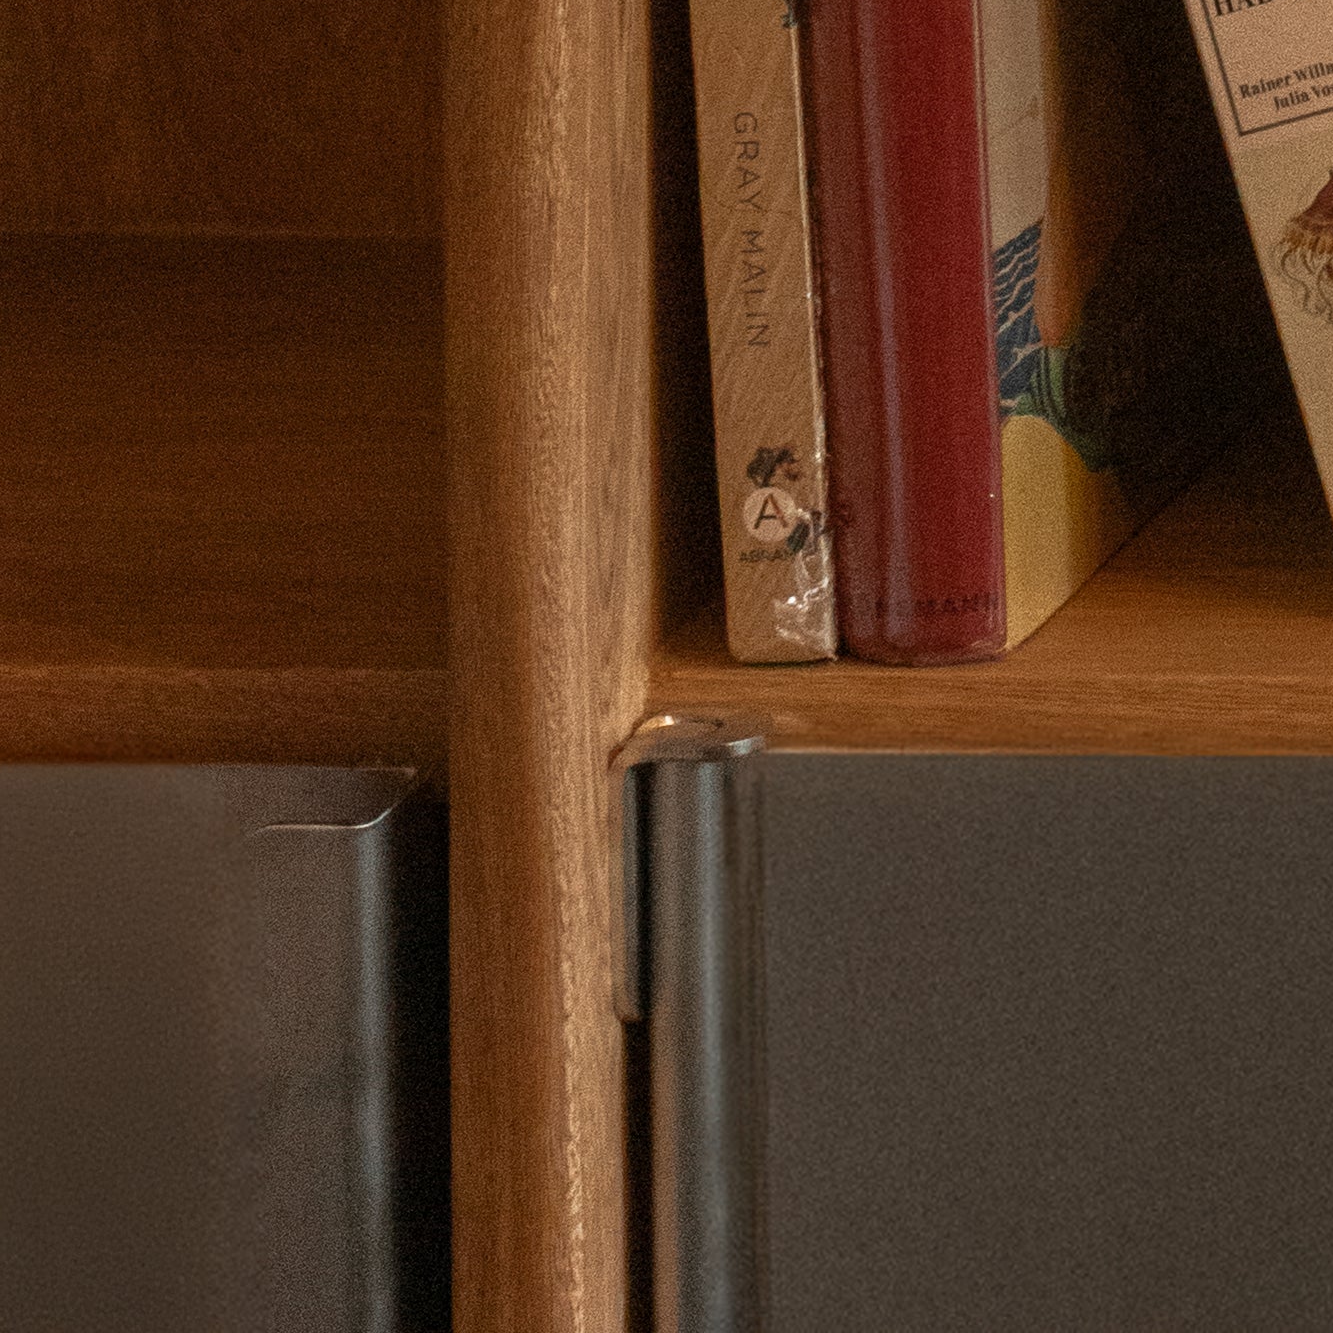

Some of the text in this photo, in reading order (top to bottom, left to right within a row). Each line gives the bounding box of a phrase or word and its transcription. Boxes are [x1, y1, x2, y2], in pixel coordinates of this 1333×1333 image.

[1240, 73, 1295, 99] Rainer
[1272, 89, 1312, 113] Julia
[733, 111, 770, 348] GRAY MALIN
[753, 493, 790, 530] A
